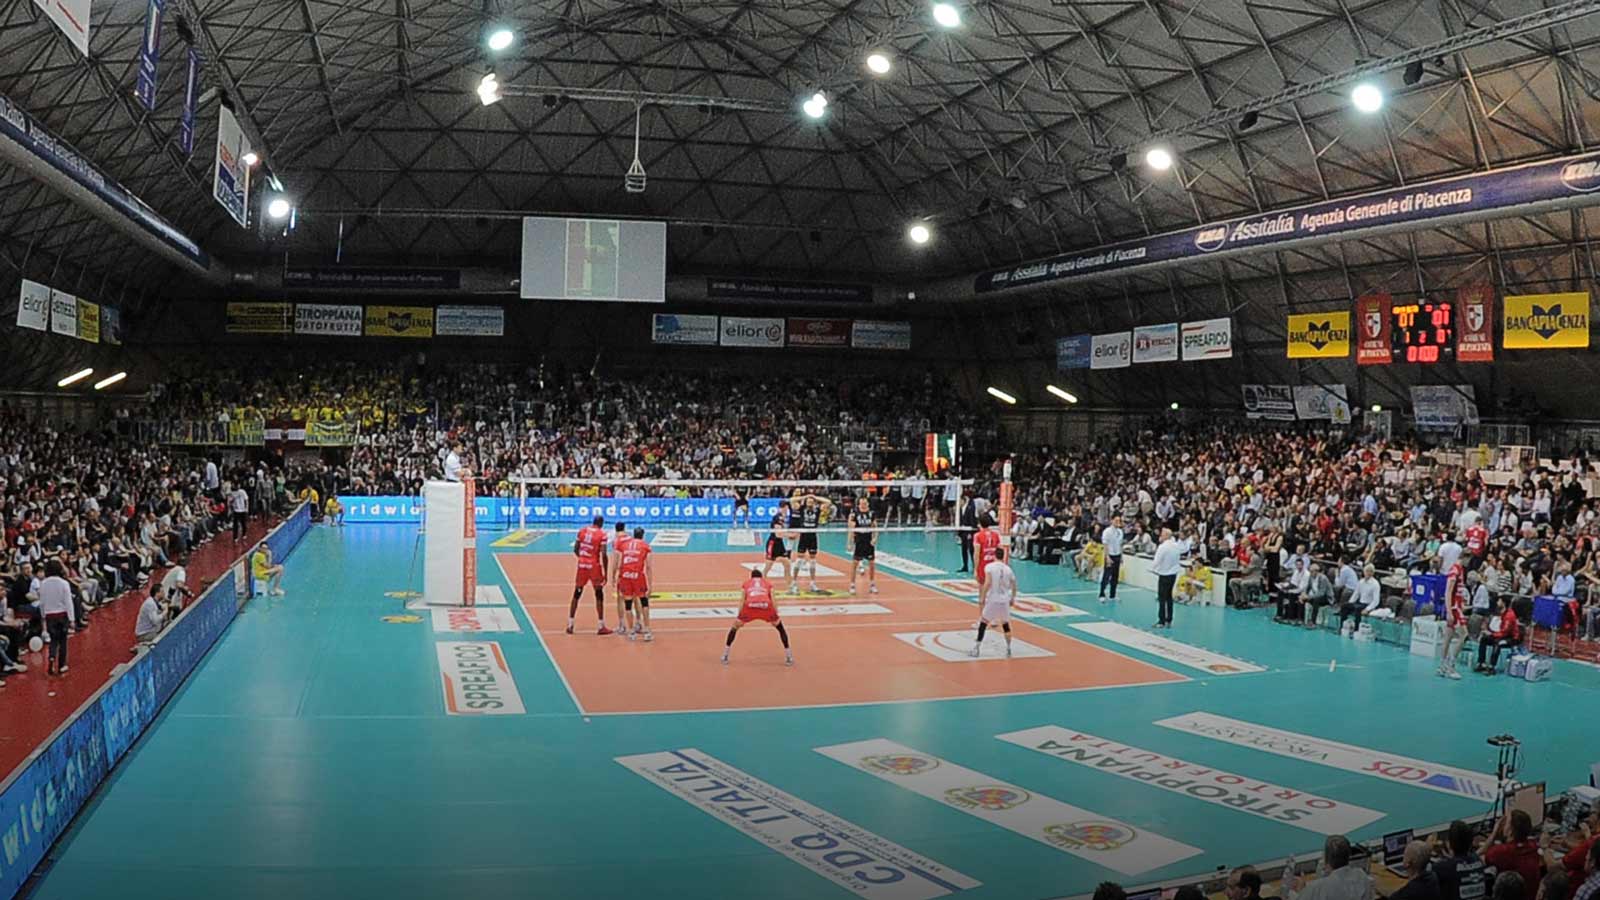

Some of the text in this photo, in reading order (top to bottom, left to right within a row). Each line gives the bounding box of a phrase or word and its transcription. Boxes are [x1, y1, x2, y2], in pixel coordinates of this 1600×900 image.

[1230, 212, 1295, 243] Assitalia
[1301, 207, 1344, 232] Agenzia
[1346, 197, 1399, 226] Generale
[1400, 193, 1414, 214] di
[1415, 186, 1472, 213] Piacenza
[295, 308, 361, 320] STROPPIANA
[295, 320, 361, 332] ORTOFRUTTA
[725, 322, 762, 338] elior
[1184, 331, 1228, 349] SPREAFICO
[453, 645, 504, 709] SPREAFICO
[658, 763, 788, 824] ITALIA
[1037, 740, 1312, 821] STROPPIANA
[1070, 734, 1336, 809] ORTOFRUTTA
[1362, 761, 1428, 780] CDS
[791, 832, 906, 884] CDQ
